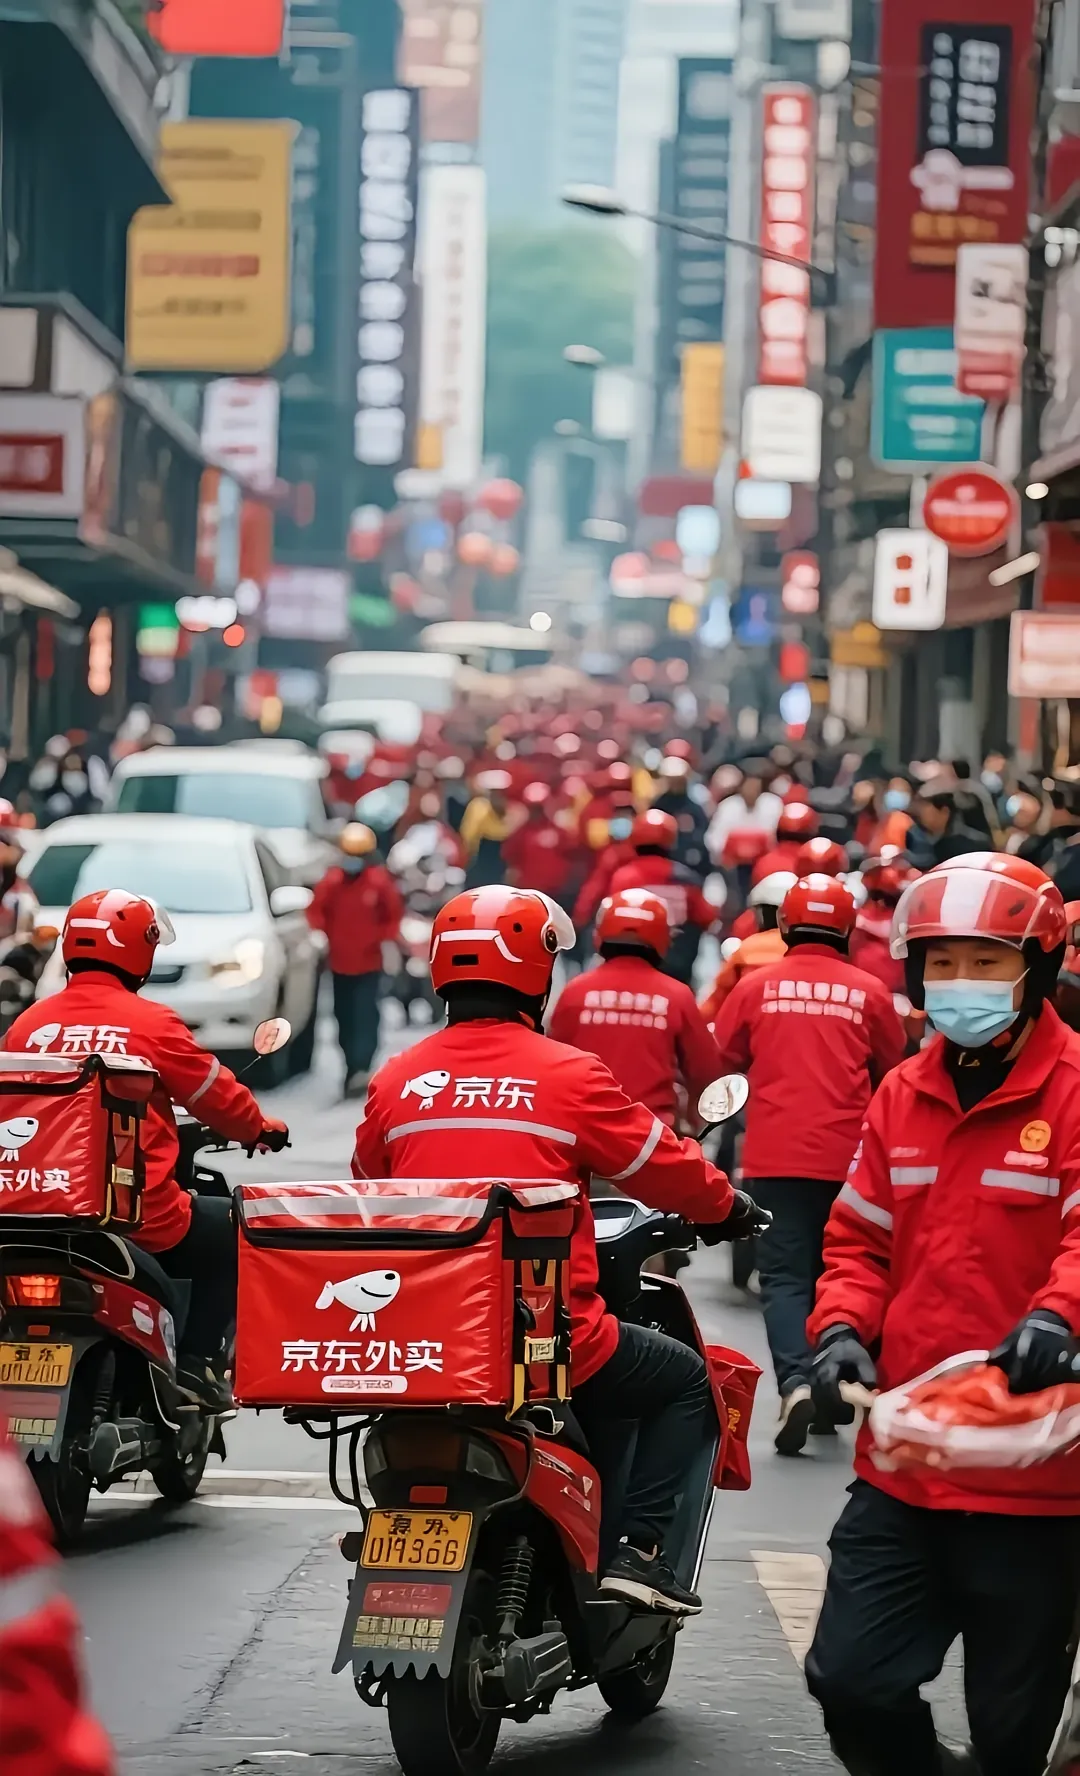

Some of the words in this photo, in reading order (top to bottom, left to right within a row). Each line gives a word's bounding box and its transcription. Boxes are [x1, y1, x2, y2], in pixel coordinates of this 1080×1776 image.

[62, 1024, 131, 1054] 京东
[452, 1076, 538, 1112] 京东
[280, 1338, 444, 1373] 京东外卖
